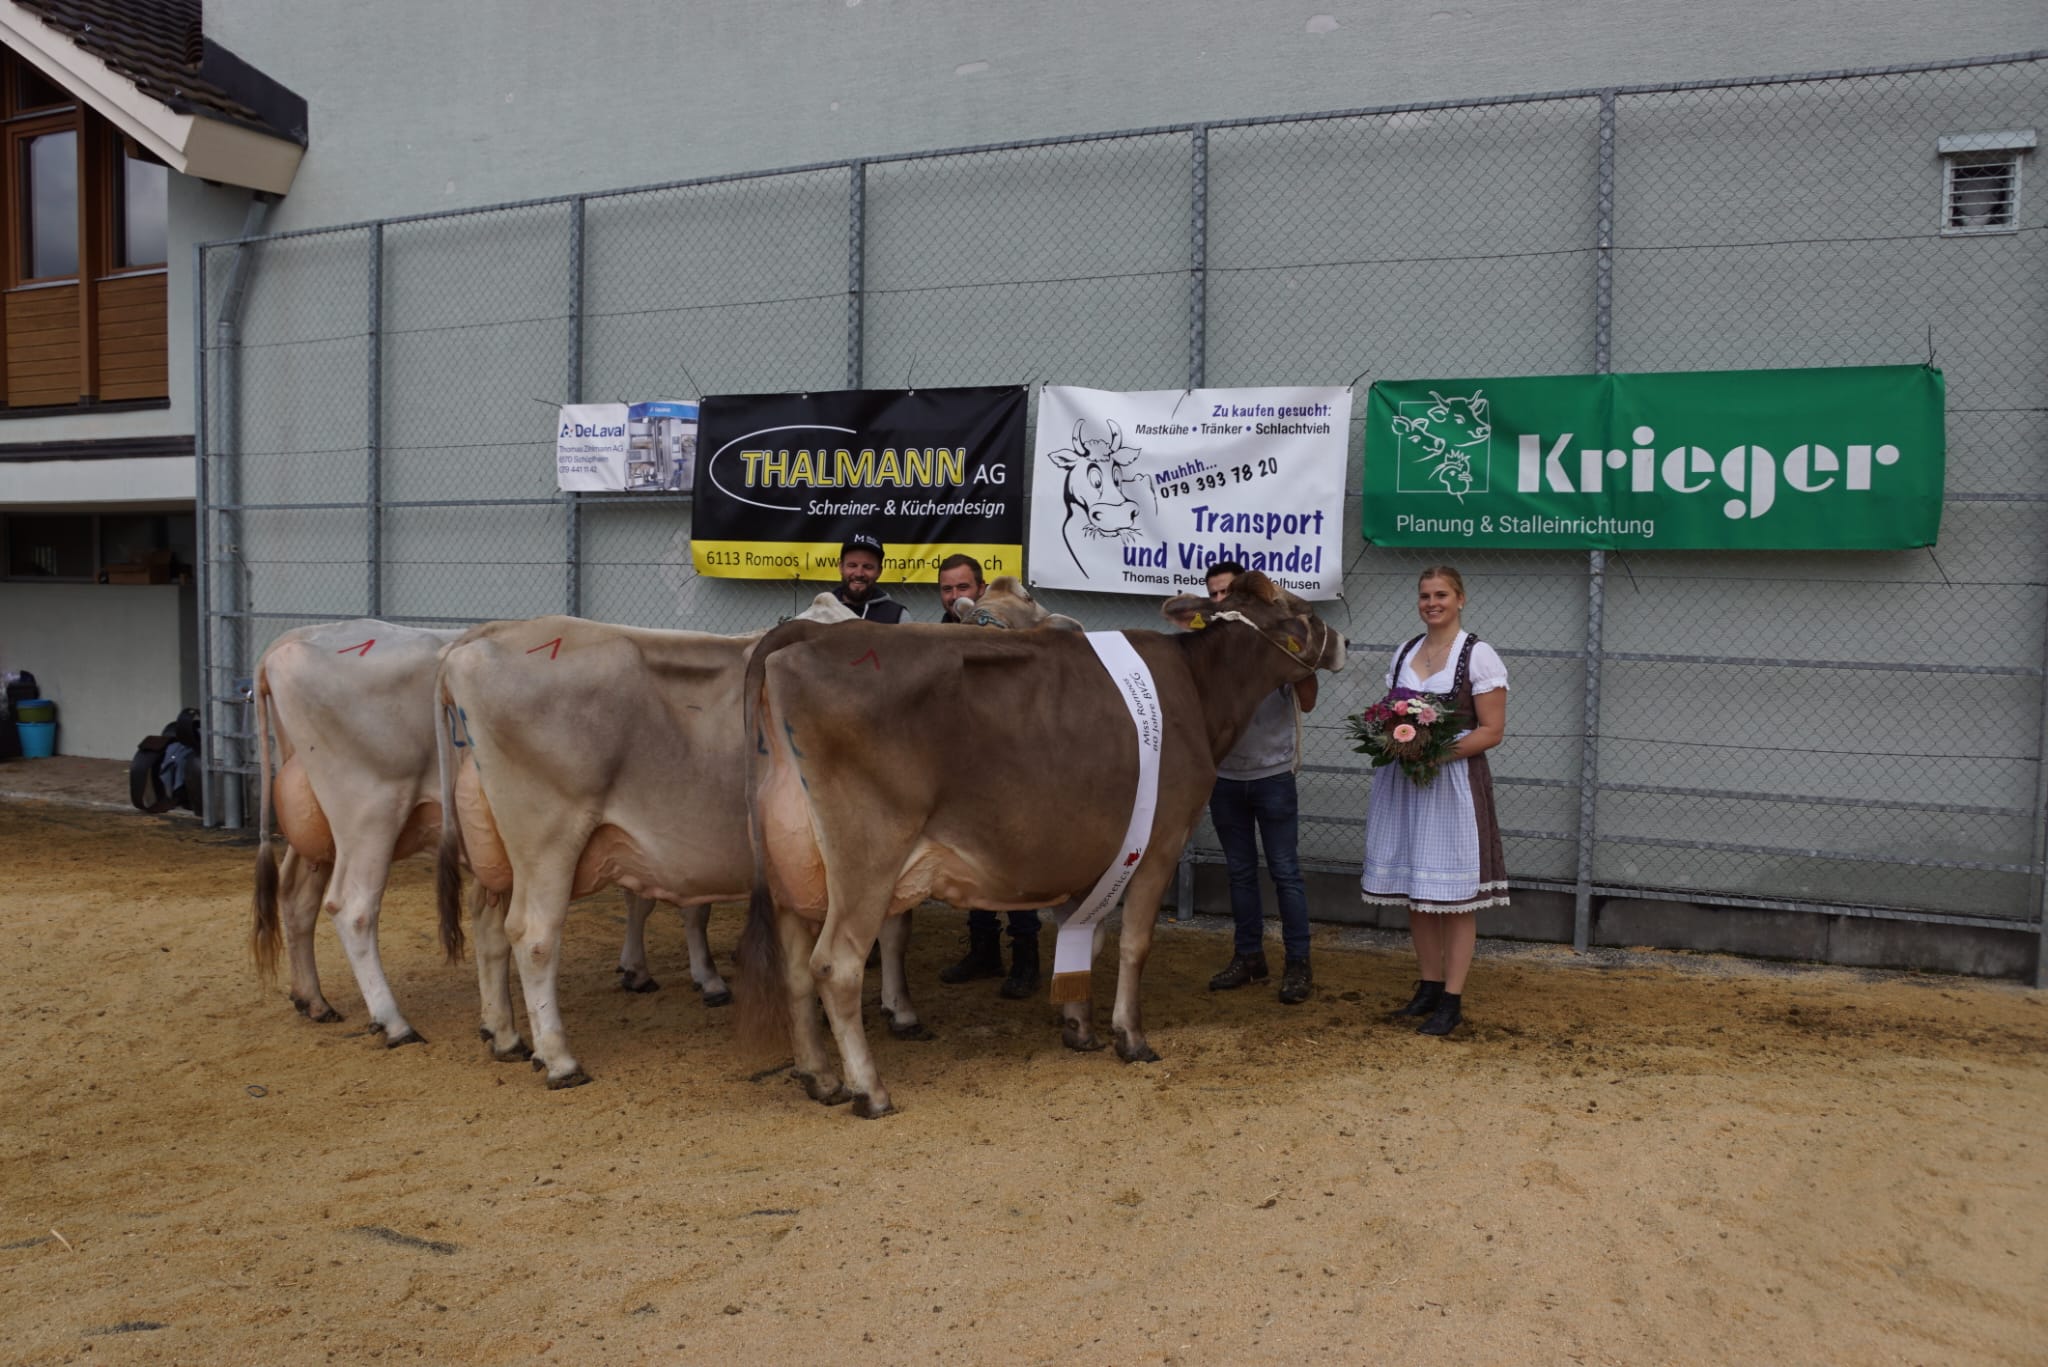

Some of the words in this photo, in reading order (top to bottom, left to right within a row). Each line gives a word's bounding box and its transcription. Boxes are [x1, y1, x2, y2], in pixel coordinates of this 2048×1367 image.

[1212, 404, 1229, 418] Zu
[1232, 404, 1275, 417] kaufen
[1278, 403, 1331, 419] gesucht:
[575, 424, 625, 438] DeLaval
[1135, 424, 1189, 435] Mastkühe
[1200, 423, 1243, 435] Tränker
[1255, 422, 1330, 435] Schlachtvieh
[613, 444, 624, 452] AG
[740, 447, 966, 488] THALMANN
[973, 463, 1006, 485] AG
[1155, 458, 1218, 485] Muhhh...
[1160, 482, 1190, 499] 079
[1195, 471, 1226, 491] 393
[1230, 464, 1253, 483] 78
[1258, 457, 1278, 477] 20
[1518, 425, 1900, 520] Krieger
[807, 499, 881, 516] Schreiner-
[884, 500, 897, 516] &
[900, 499, 1005, 519] Küchendesign
[1190, 505, 1324, 540] Transport
[1396, 514, 1474, 537] Planung
[1480, 515, 1494, 533] &
[1499, 515, 1655, 538] Stalleinrichtung
[706, 551, 740, 566] 6113
[745, 551, 800, 567] Romoos
[1123, 541, 1168, 569] und
[1178, 542, 1323, 574] Viehhandel
[1122, 571, 1170, 585] Thomas
[1173, 574, 1206, 586] Rebe
[1269, 577, 1321, 590] lhusen
[1142, 719, 1151, 746] Miss
